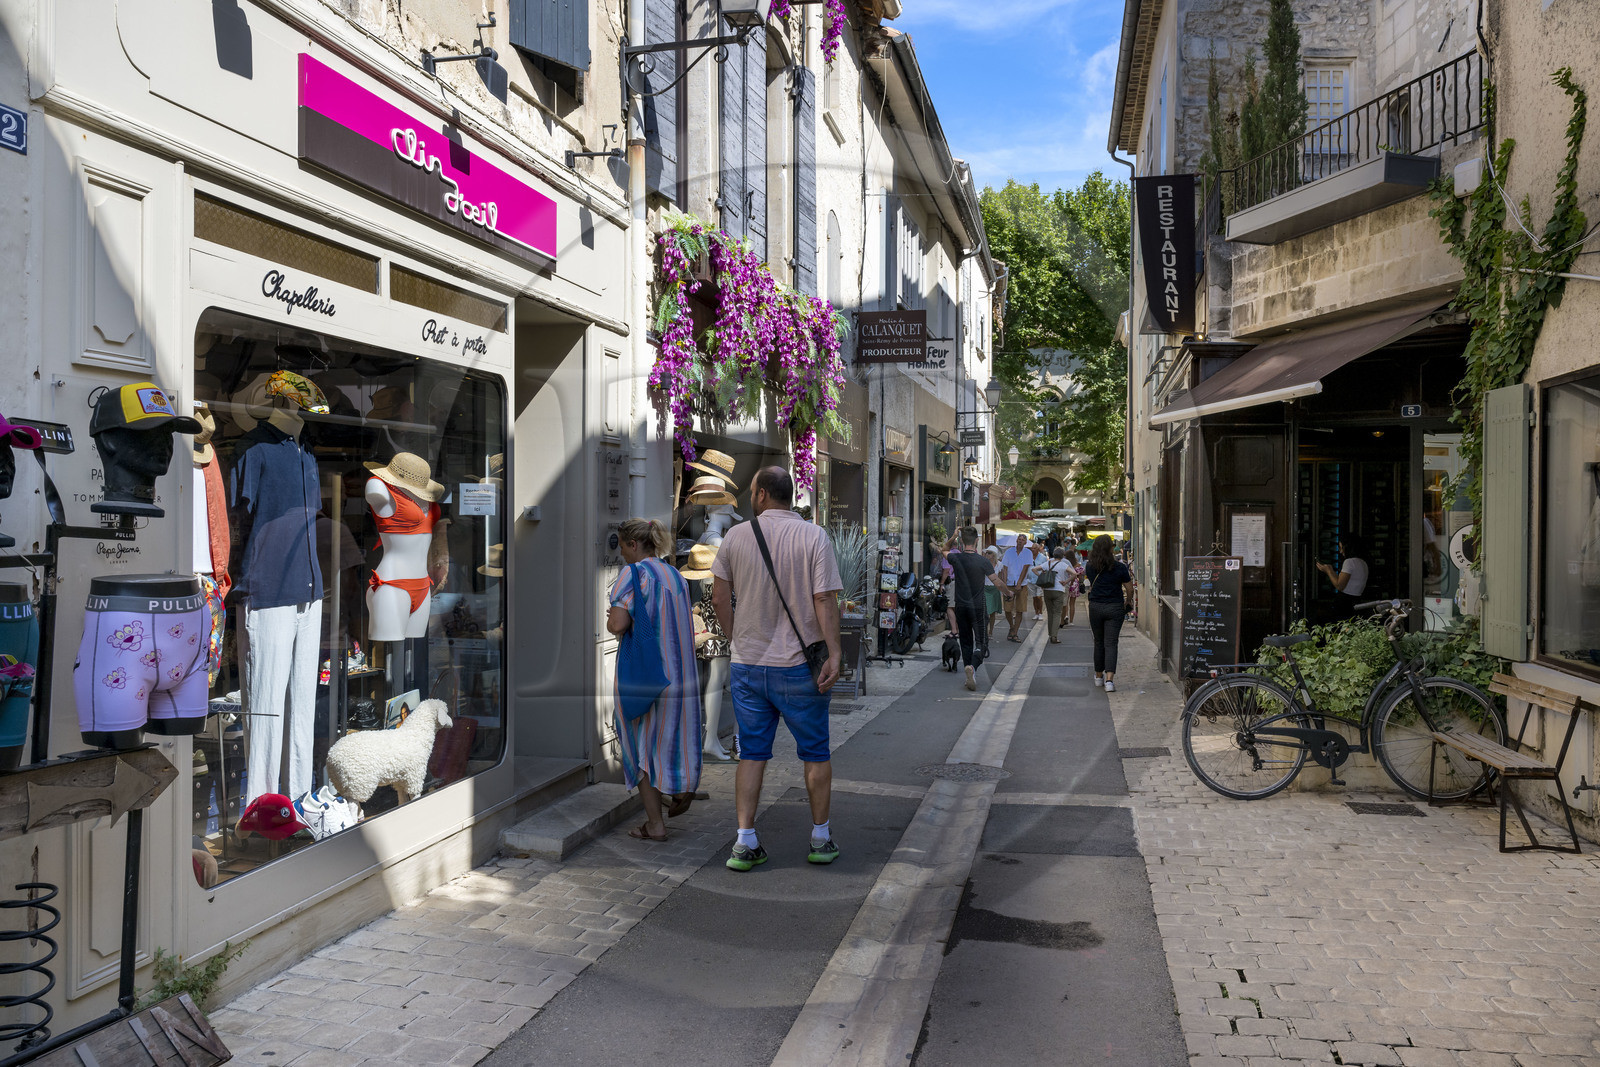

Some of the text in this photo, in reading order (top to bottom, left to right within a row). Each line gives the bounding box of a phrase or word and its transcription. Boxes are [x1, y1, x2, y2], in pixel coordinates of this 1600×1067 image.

[1157, 185, 1179, 322] RESTAURANT
[262, 269, 336, 317] Chapellerie
[861, 323, 923, 337] CALANQUET
[462, 336, 487, 356] porter
[862, 347, 922, 357] PRODUCTEUR
[1407, 406, 1415, 416] 5
[73, 493, 104, 502] TOMM
[96, 542, 116, 558] Pepe
[1455, 550, 1465, 564] LES
[148, 596, 203, 611] PULLIN
